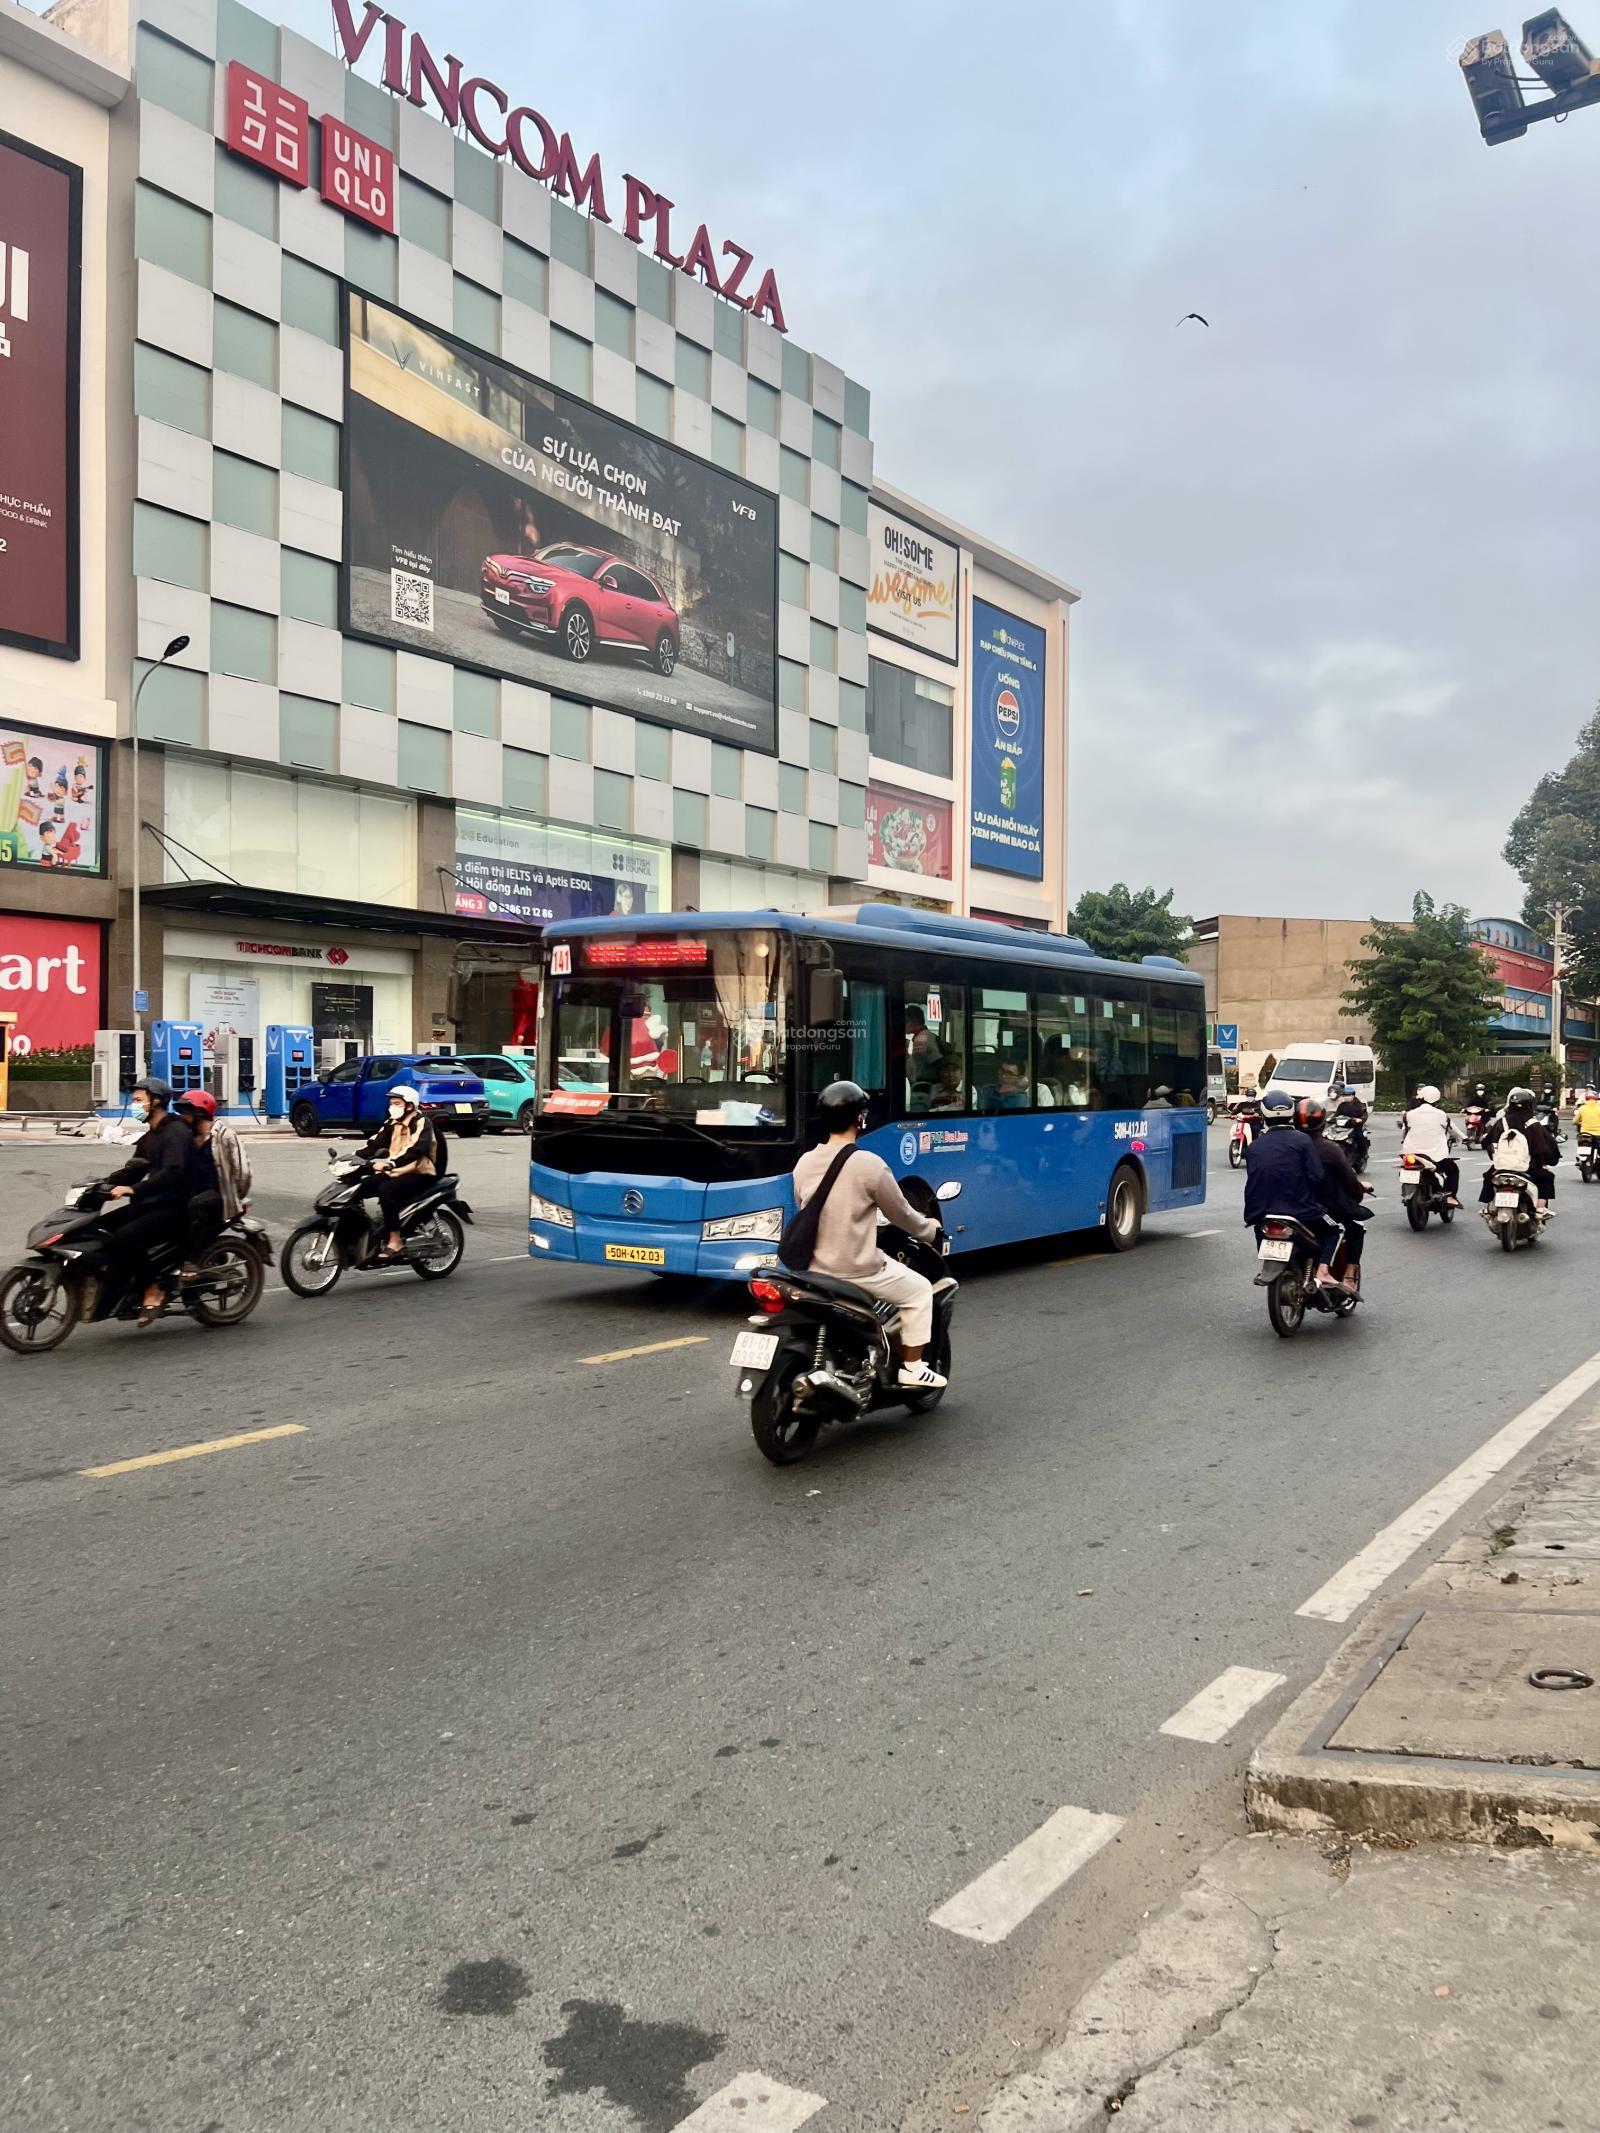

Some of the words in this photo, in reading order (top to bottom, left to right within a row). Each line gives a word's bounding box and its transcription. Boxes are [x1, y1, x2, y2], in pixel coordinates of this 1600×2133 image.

[331, 0, 612, 222] VINCOM
[622, 173, 788, 333] PLAZA
[334, 129, 381, 183] UNI
[334, 167, 386, 216] QLO
[419, 361, 480, 398] VINFAST
[542, 435, 567, 462] SỰ
[568, 447, 600, 475] LỰA
[603, 464, 648, 496] CHỌN
[501, 447, 536, 476] CỦA
[541, 463, 592, 500] NGƯỜI
[598, 487, 650, 524] THÀNH
[652, 511, 681, 537] ĐẠT
[998, 705, 1019, 721] PEPSI
[476, 832, 520, 849] Education
[464, 861, 489, 876] điểm
[491, 865, 505, 878] thi
[506, 867, 531, 882] IELTS
[532, 872, 544, 884] và
[545, 875, 569, 888] Aptis
[570, 878, 593, 892] ESOL
[513, 883, 532, 897] Anh
[476, 899, 483, 910] 3
[236, 941, 323, 960] TECHCOMBANK
[554, 949, 570, 972] 141
[929, 999, 941, 1020] 141
